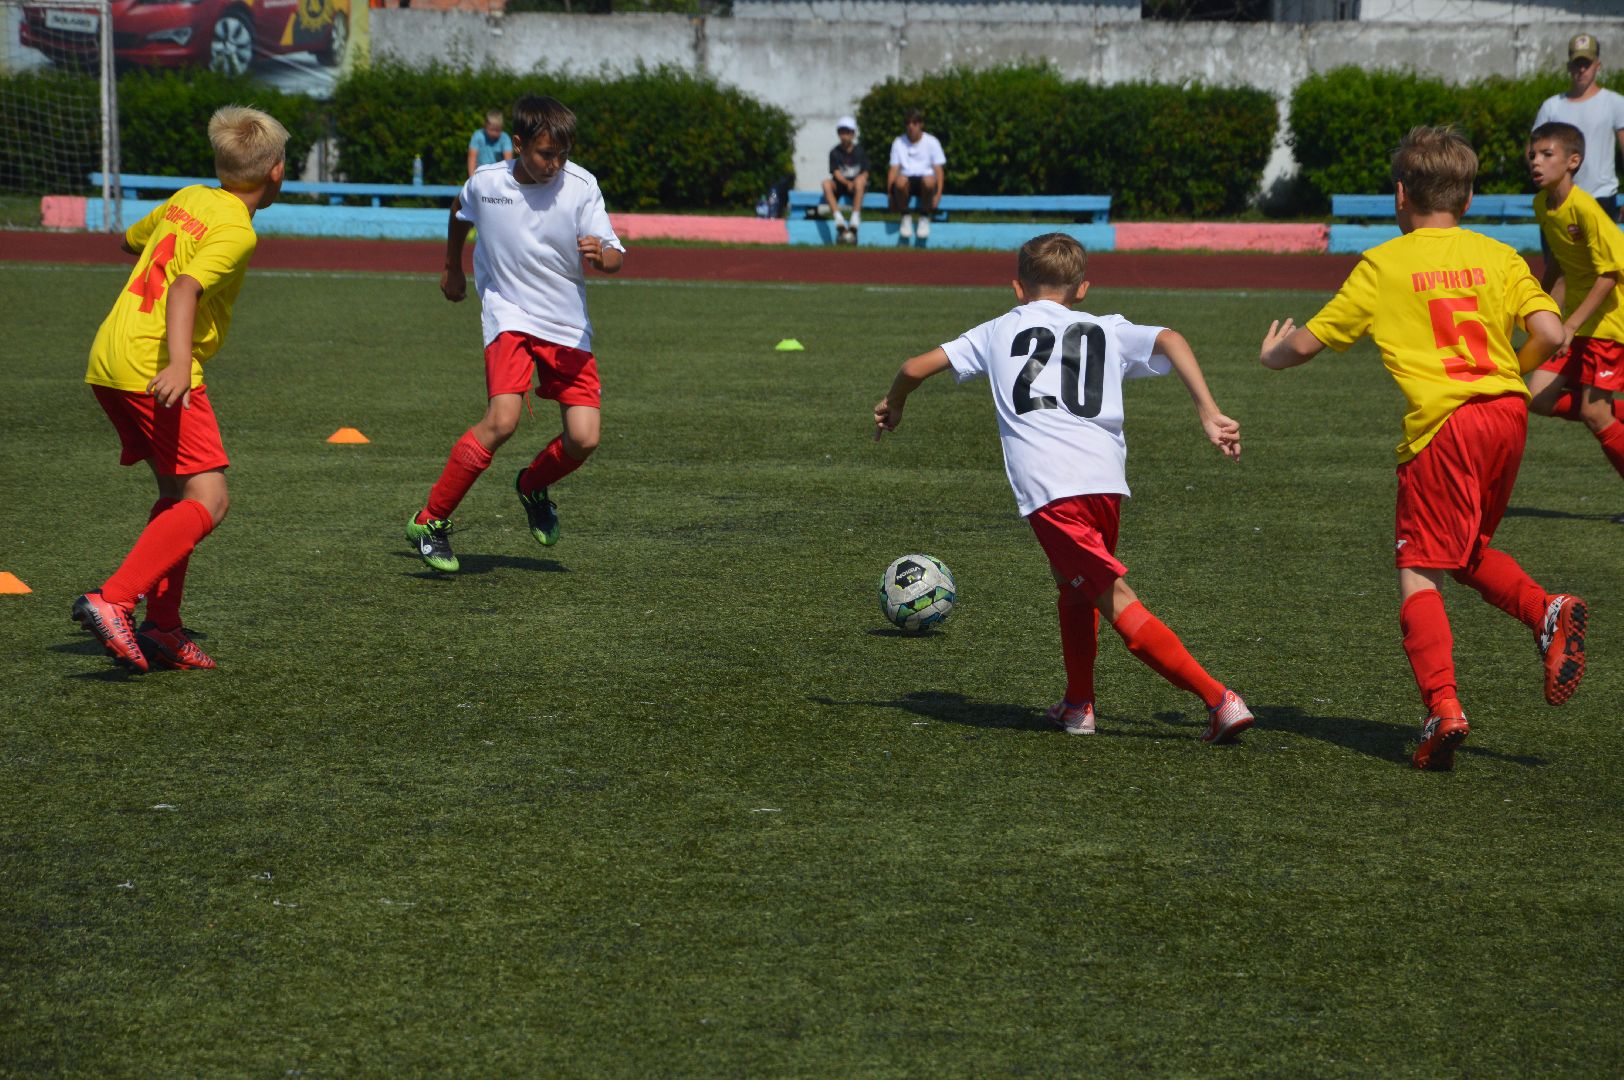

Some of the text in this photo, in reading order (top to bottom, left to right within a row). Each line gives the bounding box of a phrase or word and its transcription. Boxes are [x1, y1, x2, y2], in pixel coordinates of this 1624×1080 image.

[481, 195, 513, 205] macron
[127, 232, 178, 314] 4
[1411, 267, 1486, 292] ПУЧКОВ
[1010, 321, 1106, 419] 20
[1427, 295, 1498, 382] 5
